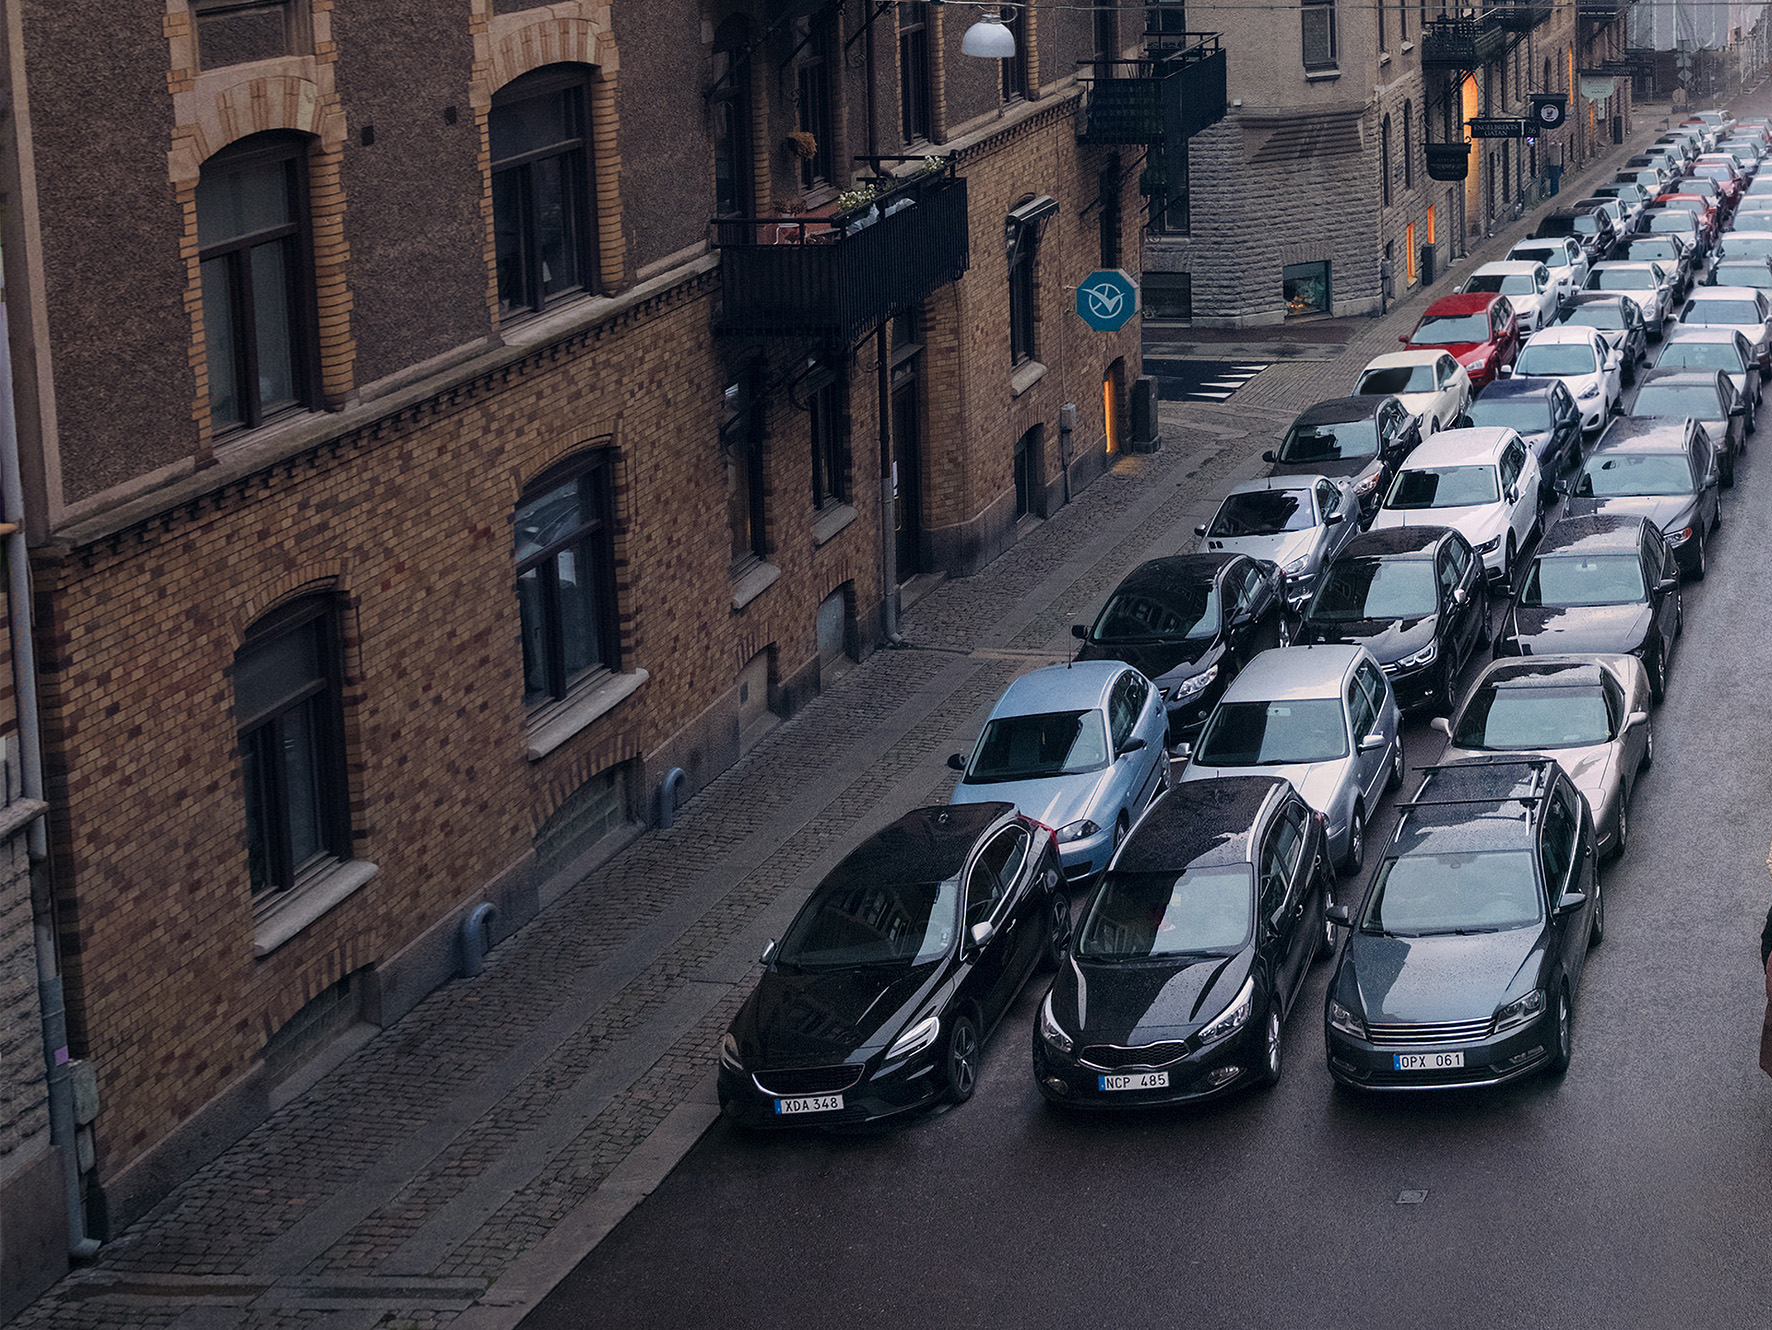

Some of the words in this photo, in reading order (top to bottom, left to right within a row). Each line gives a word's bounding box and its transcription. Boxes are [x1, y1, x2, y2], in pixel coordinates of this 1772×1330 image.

[1401, 1056, 1426, 1068] OPX
[1436, 1054, 1460, 1066] 061
[1106, 1077, 1131, 1088] NCP
[1141, 1074, 1166, 1086] 485
[785, 1099, 810, 1112] XDA
[813, 1097, 838, 1110] 348
